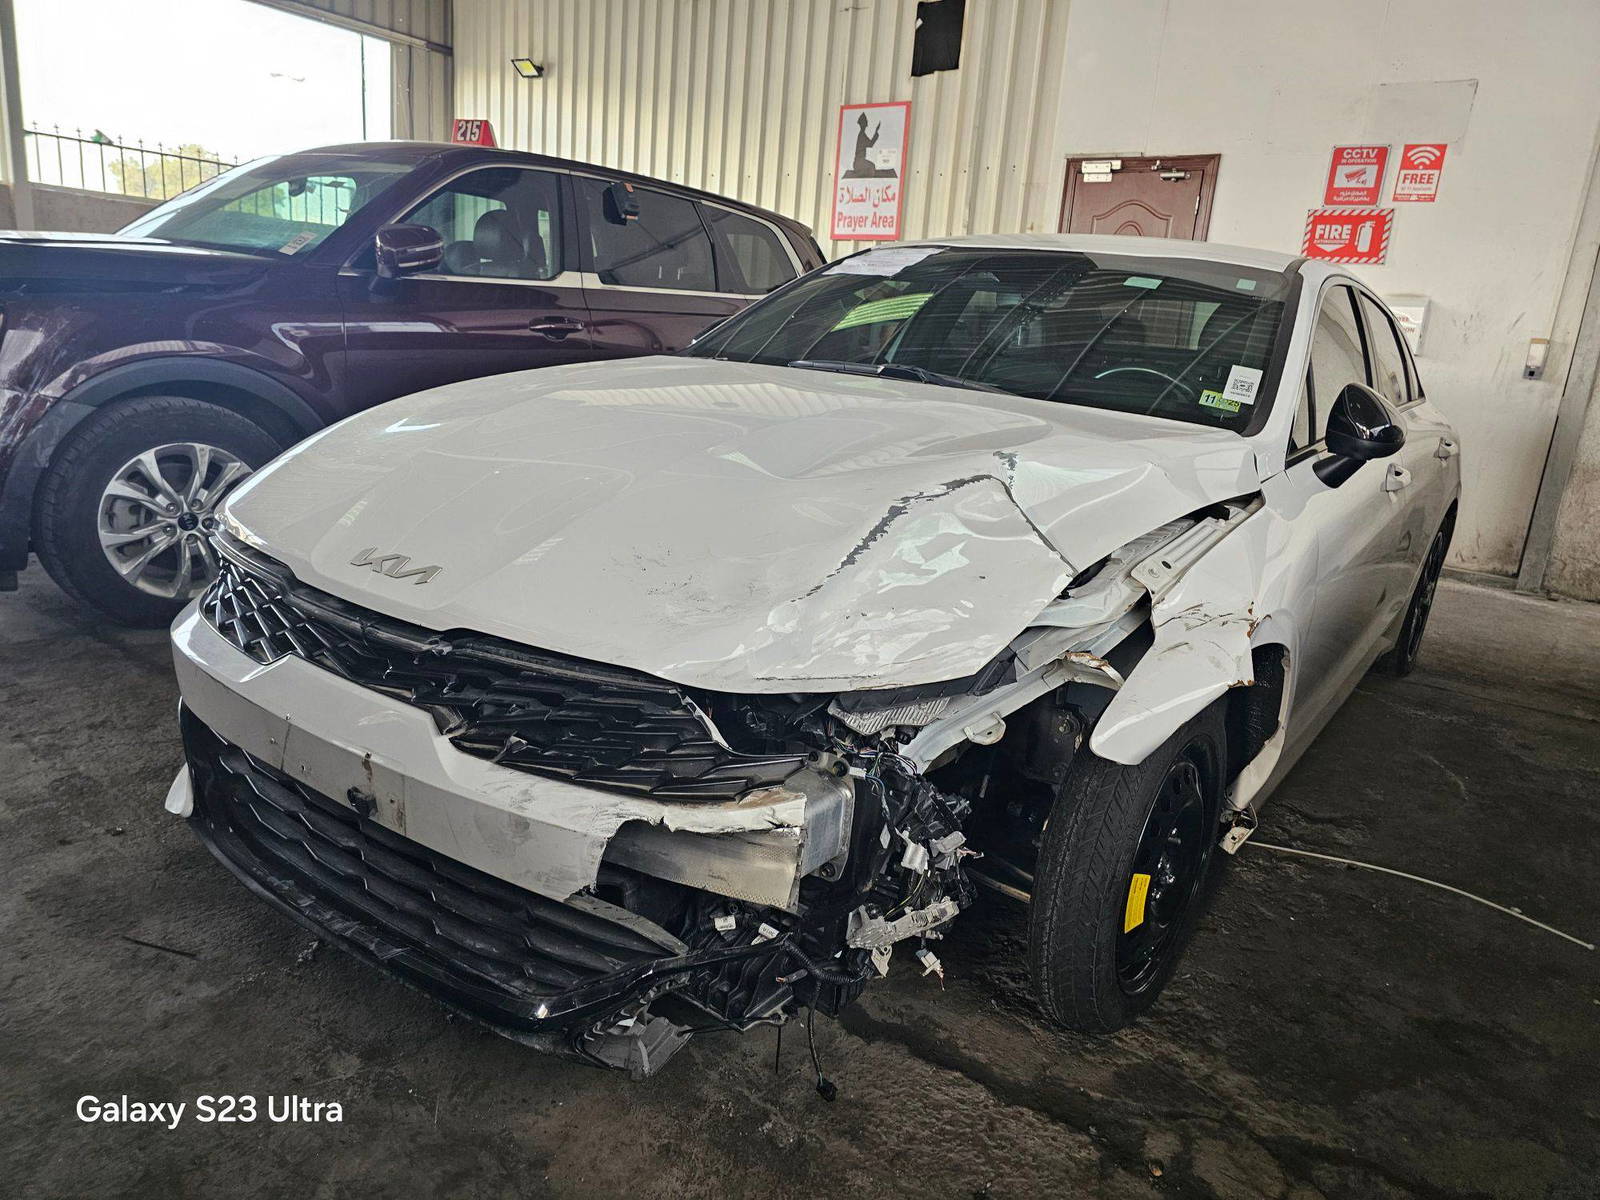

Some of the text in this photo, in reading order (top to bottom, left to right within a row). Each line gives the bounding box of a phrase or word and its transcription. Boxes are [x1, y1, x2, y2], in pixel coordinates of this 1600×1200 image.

[457, 120, 481, 141] 215
[1343, 148, 1378, 159] CCTV
[1402, 173, 1435, 184] FREE
[839, 184, 897, 208] مكان الصلاة
[837, 211, 895, 232] Prayer Area
[1315, 224, 1352, 239] FIRE
[1204, 394, 1216, 404] 11
[350, 545, 443, 585] KIA
